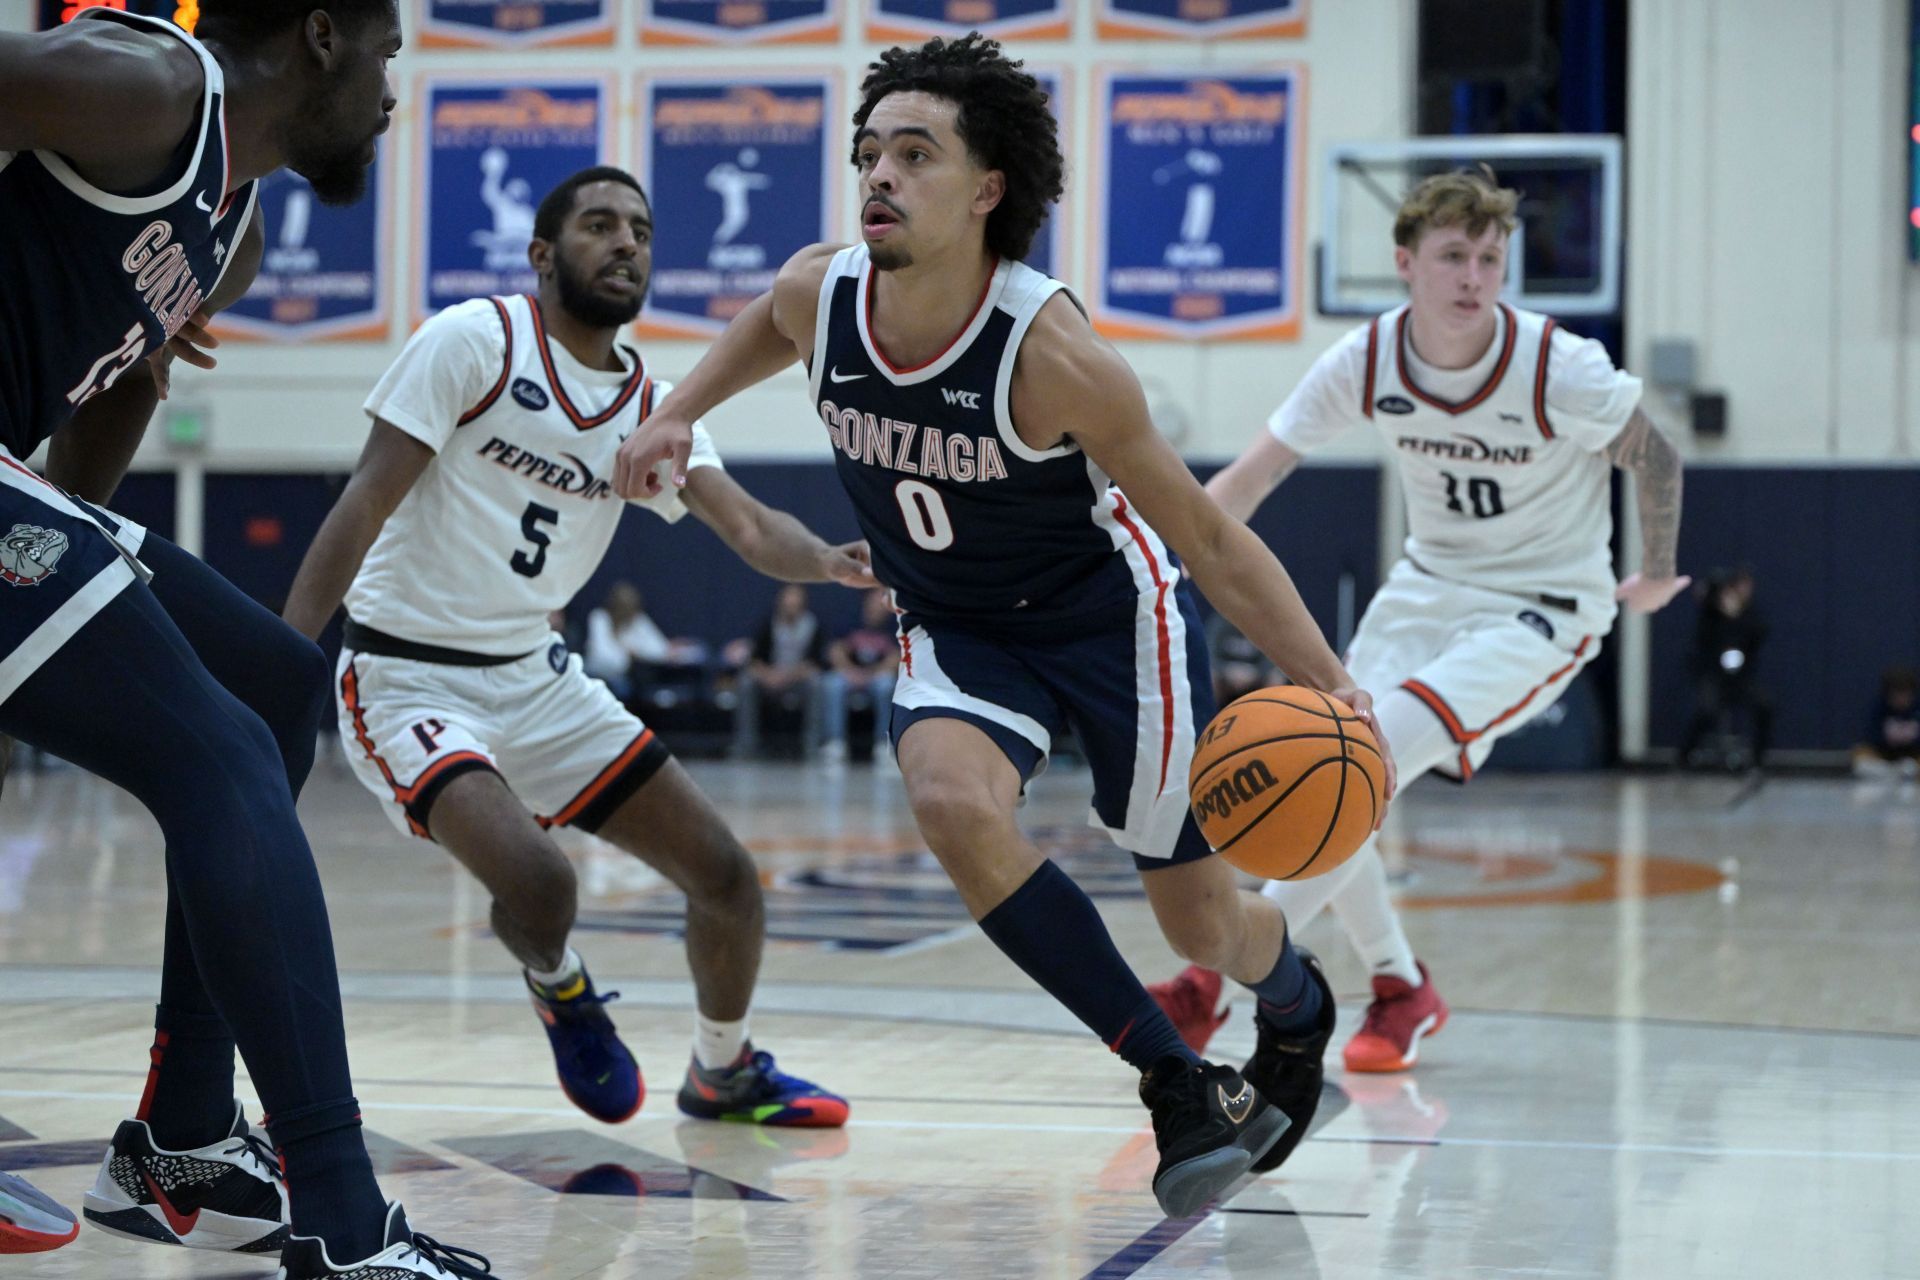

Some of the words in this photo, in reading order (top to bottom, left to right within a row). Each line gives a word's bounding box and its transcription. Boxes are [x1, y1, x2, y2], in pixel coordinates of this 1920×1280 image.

[66, 321, 147, 406] 13
[940, 387, 982, 410] WCC
[820, 400, 1009, 483] GONZAGA
[1397, 432, 1534, 465] PEPPERDINE
[895, 479, 954, 552] 0
[1440, 470, 1505, 519] 10
[510, 501, 559, 579] 5
[411, 717, 447, 756] P
[1194, 759, 1280, 826] Wilso
